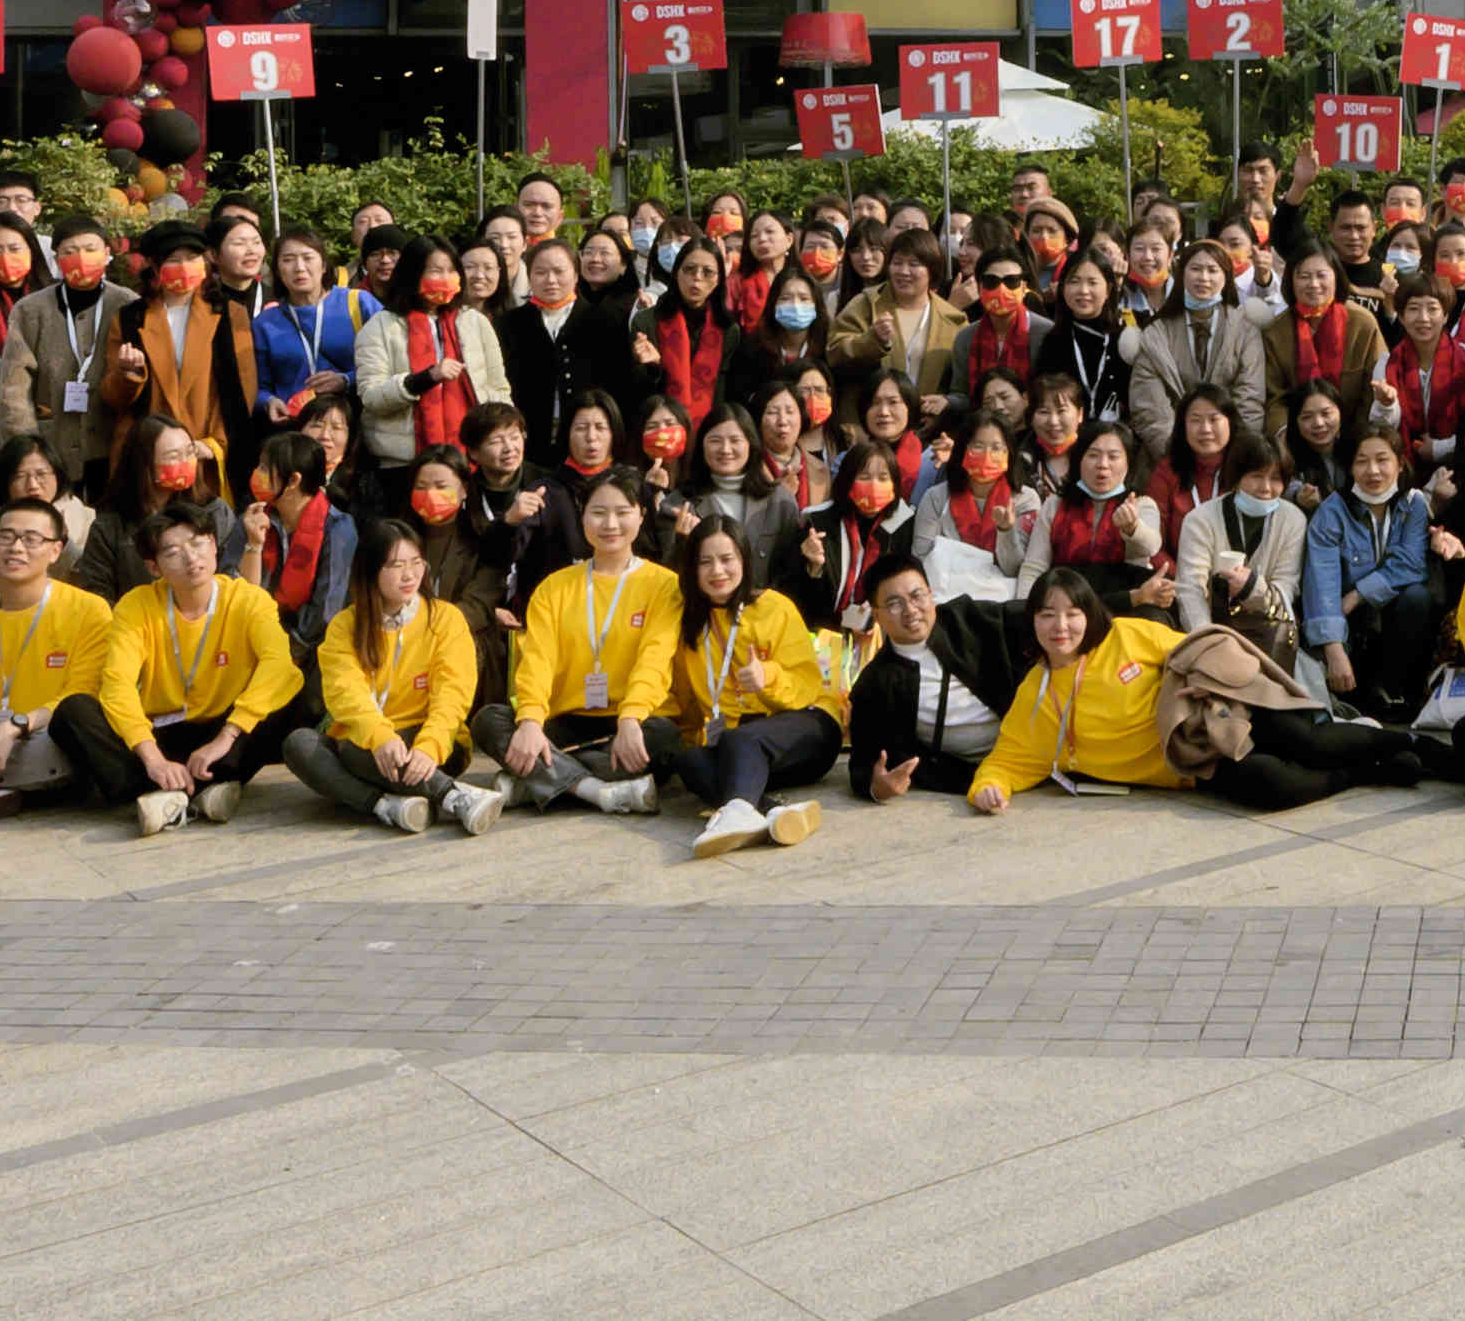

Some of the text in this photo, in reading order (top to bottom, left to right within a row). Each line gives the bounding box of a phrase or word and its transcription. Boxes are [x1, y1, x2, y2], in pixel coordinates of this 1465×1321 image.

[664, 25, 691, 64] 3
[1093, 15, 1141, 57] 17
[1225, 12, 1251, 51] 2
[250, 51, 279, 91] 9
[1435, 43, 1451, 81] 1
[927, 71, 972, 112] 11
[831, 113, 854, 151] 5
[1336, 122, 1379, 163] 10
